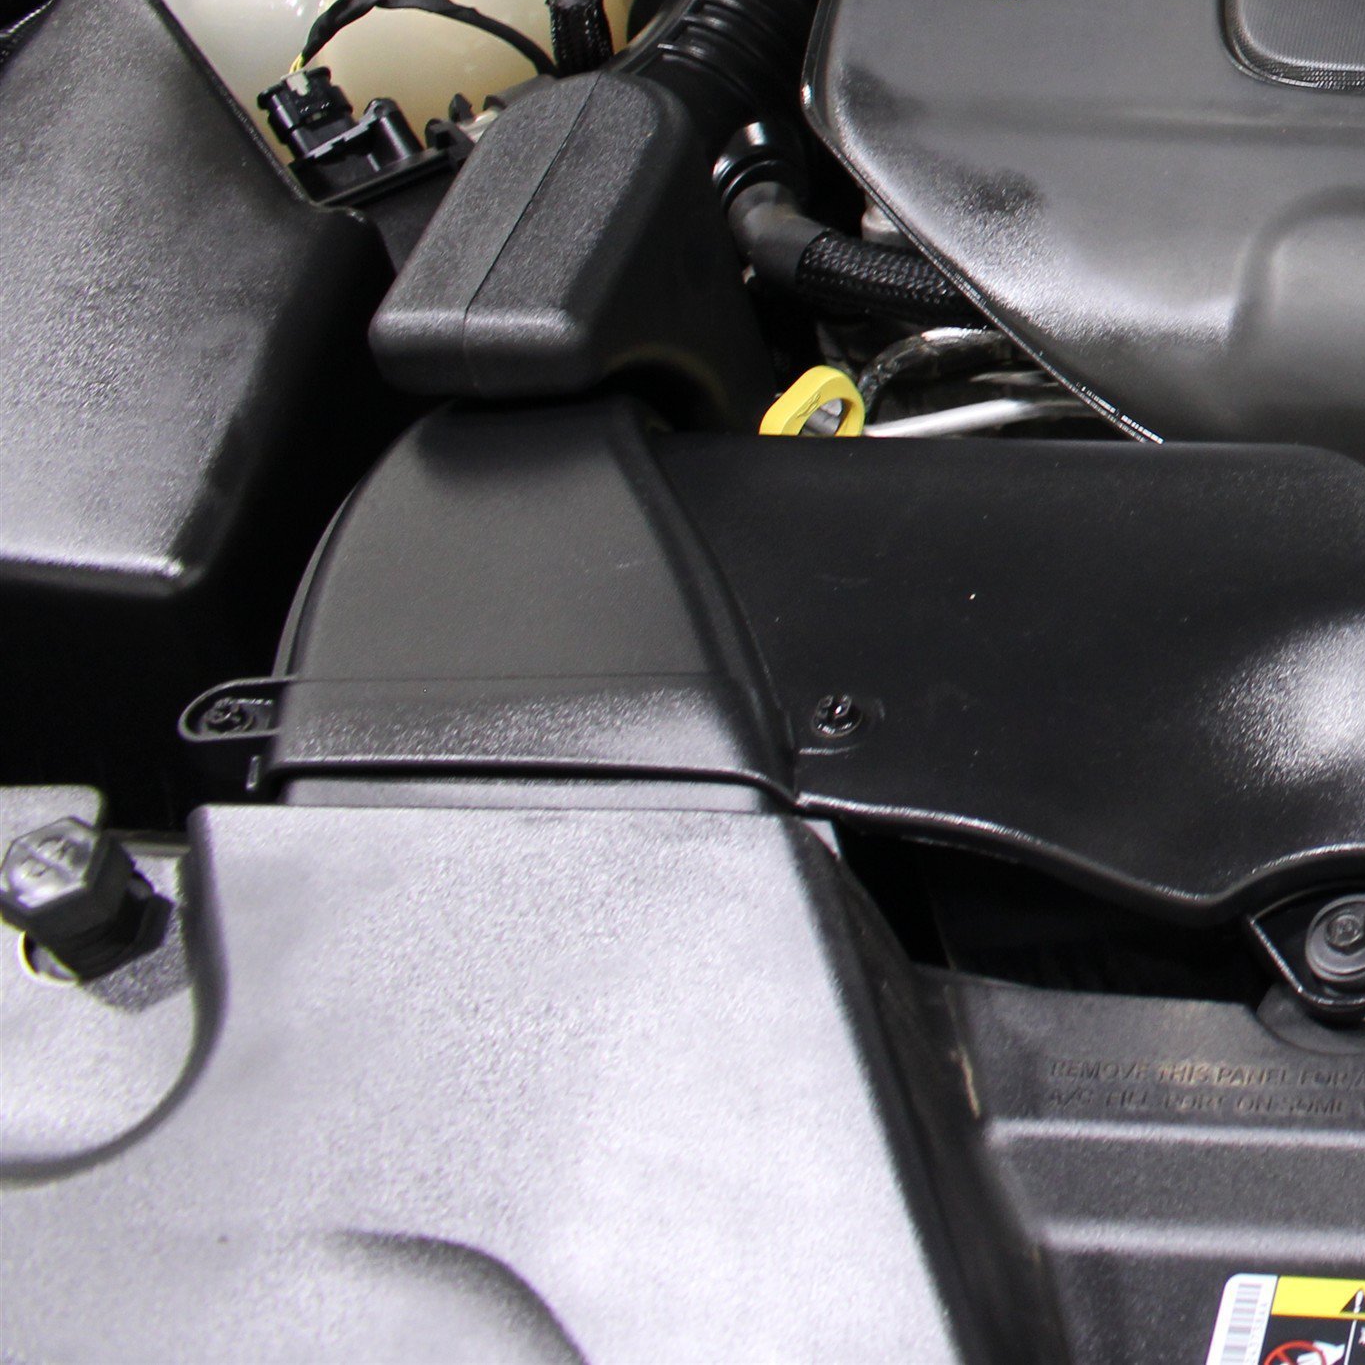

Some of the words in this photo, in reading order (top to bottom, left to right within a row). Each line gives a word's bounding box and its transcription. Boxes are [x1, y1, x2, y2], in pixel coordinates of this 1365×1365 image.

[1050, 1060, 1149, 1081] REMOVE
[1157, 1061, 1210, 1083] THIS
[1214, 1065, 1287, 1086] PANEL
[1300, 1068, 1348, 1086] FOR
[1234, 1094, 1272, 1114] ON
